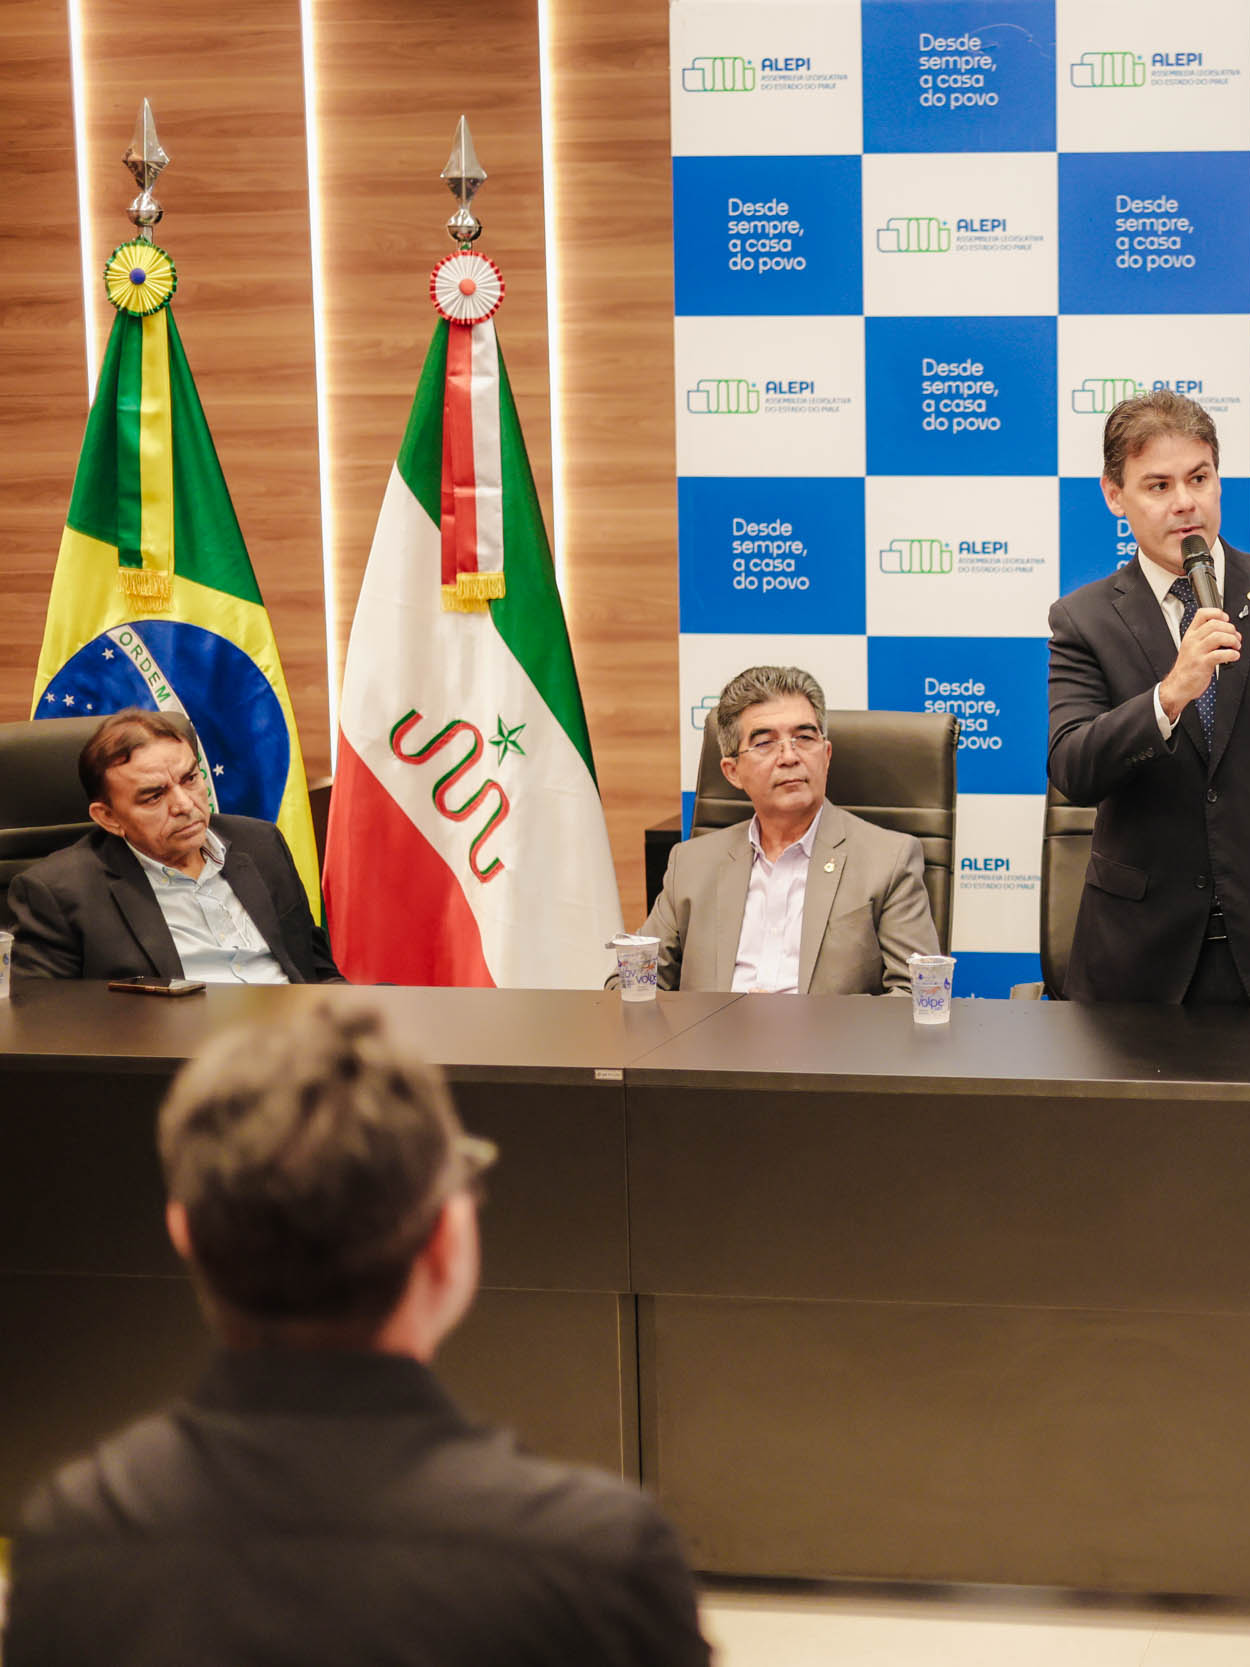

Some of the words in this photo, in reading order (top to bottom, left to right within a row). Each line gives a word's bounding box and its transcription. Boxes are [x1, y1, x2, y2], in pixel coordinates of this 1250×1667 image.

[920, 33, 981, 52] Desde
[761, 58, 810, 71] ALEPI
[919, 56, 996, 72] sempre,
[1152, 52, 1202, 66] ALEPI
[920, 75, 932, 88] a
[937, 74, 984, 88] casa
[920, 89, 946, 106] do
[950, 92, 999, 110] povo
[728, 198, 789, 216] Desde
[1116, 195, 1179, 213] Desde
[728, 220, 804, 238] sempre,
[957, 218, 1006, 232] ALEPI
[1116, 218, 1194, 235] sempre,
[728, 239, 741, 252] a
[745, 239, 792, 252] casa
[1116, 237, 1129, 250] a
[1133, 236, 1181, 250] casa
[729, 253, 754, 270] do
[758, 256, 806, 274] povo
[1116, 251, 1143, 268] do
[1147, 254, 1196, 272] povo
[922, 358, 984, 376] Desde
[766, 381, 814, 394] ALEPI
[922, 381, 999, 398] sempre,
[922, 399, 935, 413] a
[939, 399, 986, 413] casa
[922, 413, 949, 431] do
[952, 417, 1001, 434] povo
[733, 518, 792, 536] Desde
[732, 540, 807, 558] sempre,
[959, 541, 1008, 554] ALEPI
[733, 558, 745, 572] a
[749, 558, 795, 572] casa
[733, 572, 758, 590] do
[762, 576, 810, 593] povo
[120, 631, 171, 703] ORDEM
[925, 677, 985, 696] Desde
[924, 700, 1000, 717] sempre,
[961, 858, 1010, 871] ALEPI
